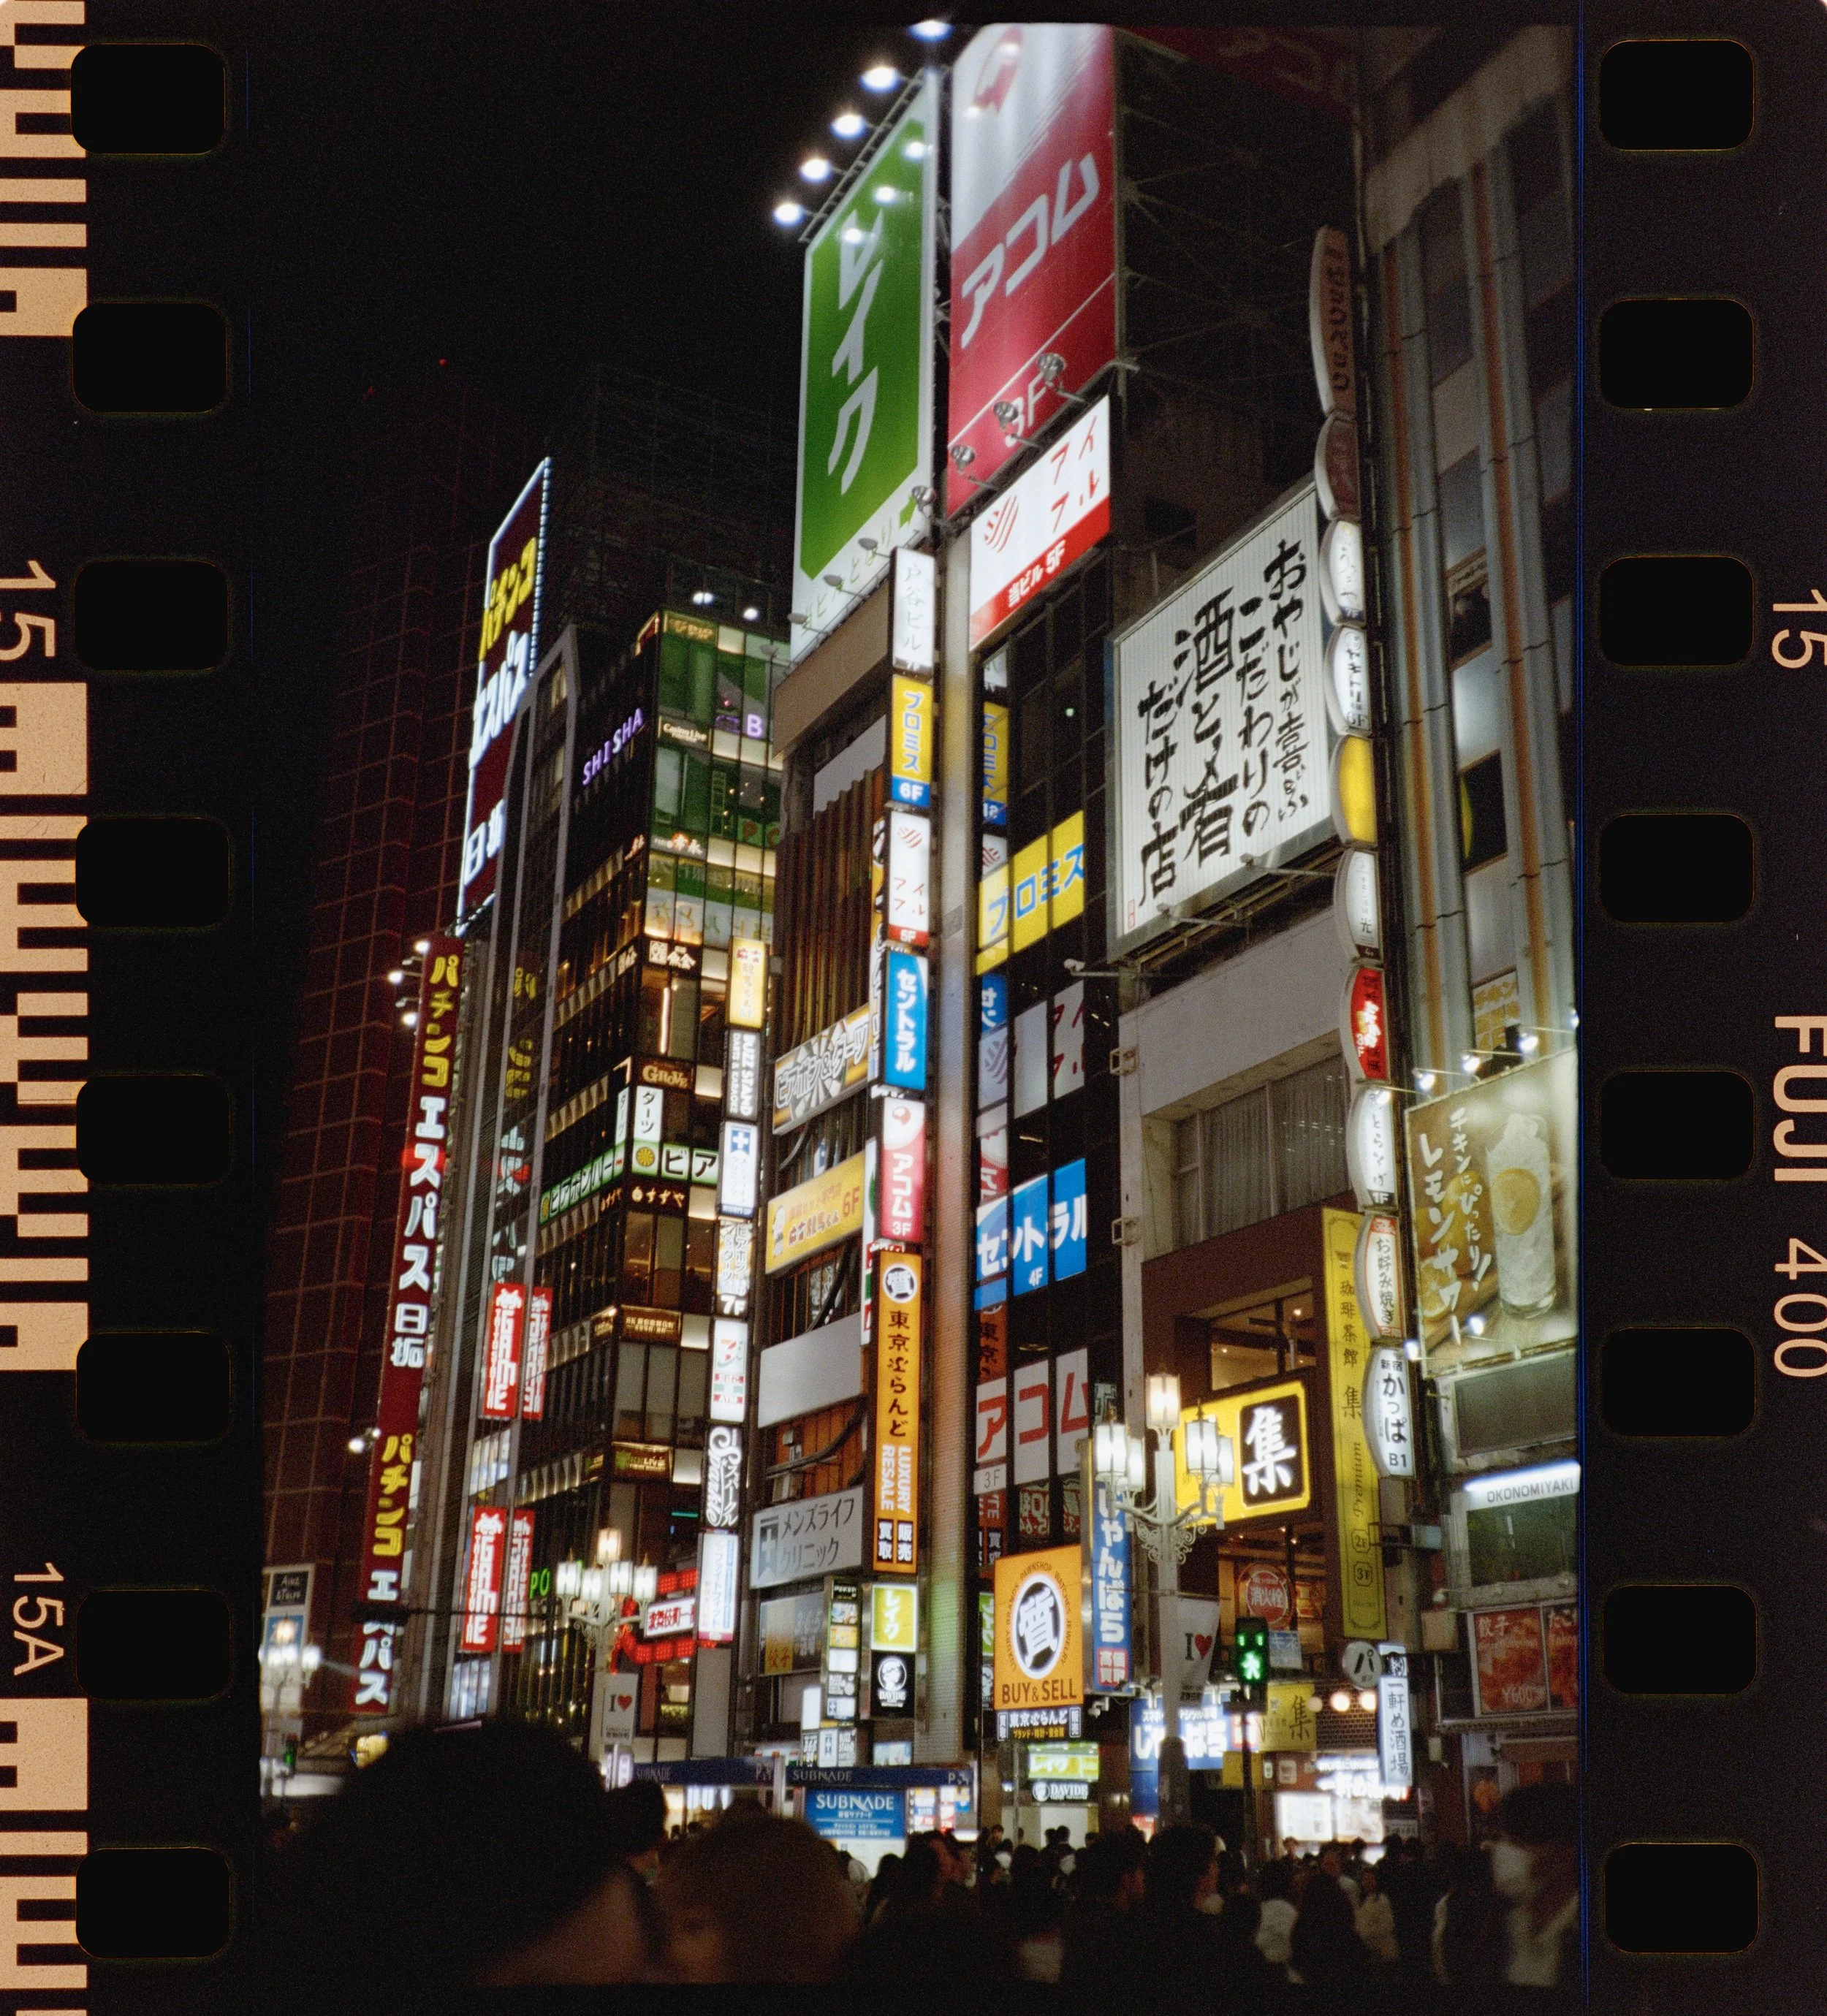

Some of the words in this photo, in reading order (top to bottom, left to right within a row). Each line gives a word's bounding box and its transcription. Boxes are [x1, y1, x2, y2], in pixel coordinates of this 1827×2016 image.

[960, 152, 1101, 349] アコム
[827, 207, 884, 497] レイク
[1045, 539, 1066, 575] 5F
[582, 707, 645, 786] SHISHA
[903, 691, 924, 772] プロミス
[1174, 585, 1239, 870] 酒と肴
[1236, 595, 1272, 839] こだわりの
[899, 781, 923, 802] 6F
[1137, 680, 1179, 907] だけの店
[987, 842, 1086, 937] プロミス
[421, 955, 460, 1088] パチンコ
[894, 968, 918, 1073] セントラル
[642, 1091, 656, 1135] ダーツ
[740, 1068, 756, 1117] STAND
[1772, 1014, 1827, 1182] FUJI
[398, 1096, 447, 1292] エスパス
[841, 1185, 861, 1218] 6F
[892, 1152, 914, 1220] アコム
[891, 1220, 912, 1236] 3F
[977, 1193, 1087, 1277] セントラル
[1418, 1132, 1463, 1347] レモンサワー
[721, 1295, 746, 1315] 7F
[1028, 1266, 1044, 1287] 4F
[1376, 1236, 1396, 1325] お好み焼き
[1772, 1236, 1827, 1380] 400
[1380, 1358, 1402, 1373] 新宿
[978, 1371, 1088, 1459] アコム
[1342, 1385, 1361, 1420] 集
[1382, 1372, 1408, 1445] かっぱ
[879, 1443, 897, 1512] RESALE
[896, 1445, 913, 1514] LUXURY
[983, 1468, 1001, 1489] 3F
[1242, 1406, 1297, 1496] 集
[1352, 1440, 1364, 1519] Premium
[1389, 1452, 1409, 1469] B1
[372, 1433, 413, 1557] パチンコ
[780, 1497, 855, 1538] メンズライフ
[1486, 1474, 1576, 1505] OKONOMIYAKI
[780, 1536, 840, 1574] クリニック
[1019, 1561, 1053, 1581] PAWNSHOP
[12, 1562, 65, 1676] 15A
[884, 1589, 900, 1641] レイク
[1250, 1586, 1285, 1607] 消火栓
[1060, 1619, 1072, 1667] JEWELRY
[878, 1691, 907, 1701] DAVIDE
[1289, 1694, 1313, 1742] 集
[1388, 1682, 1409, 1776] 一軒め酒場
[792, 1768, 852, 1783] SUBNADE
[816, 1794, 894, 1811] SUBNADE
[1049, 1784, 1088, 1796] DAVIDE
